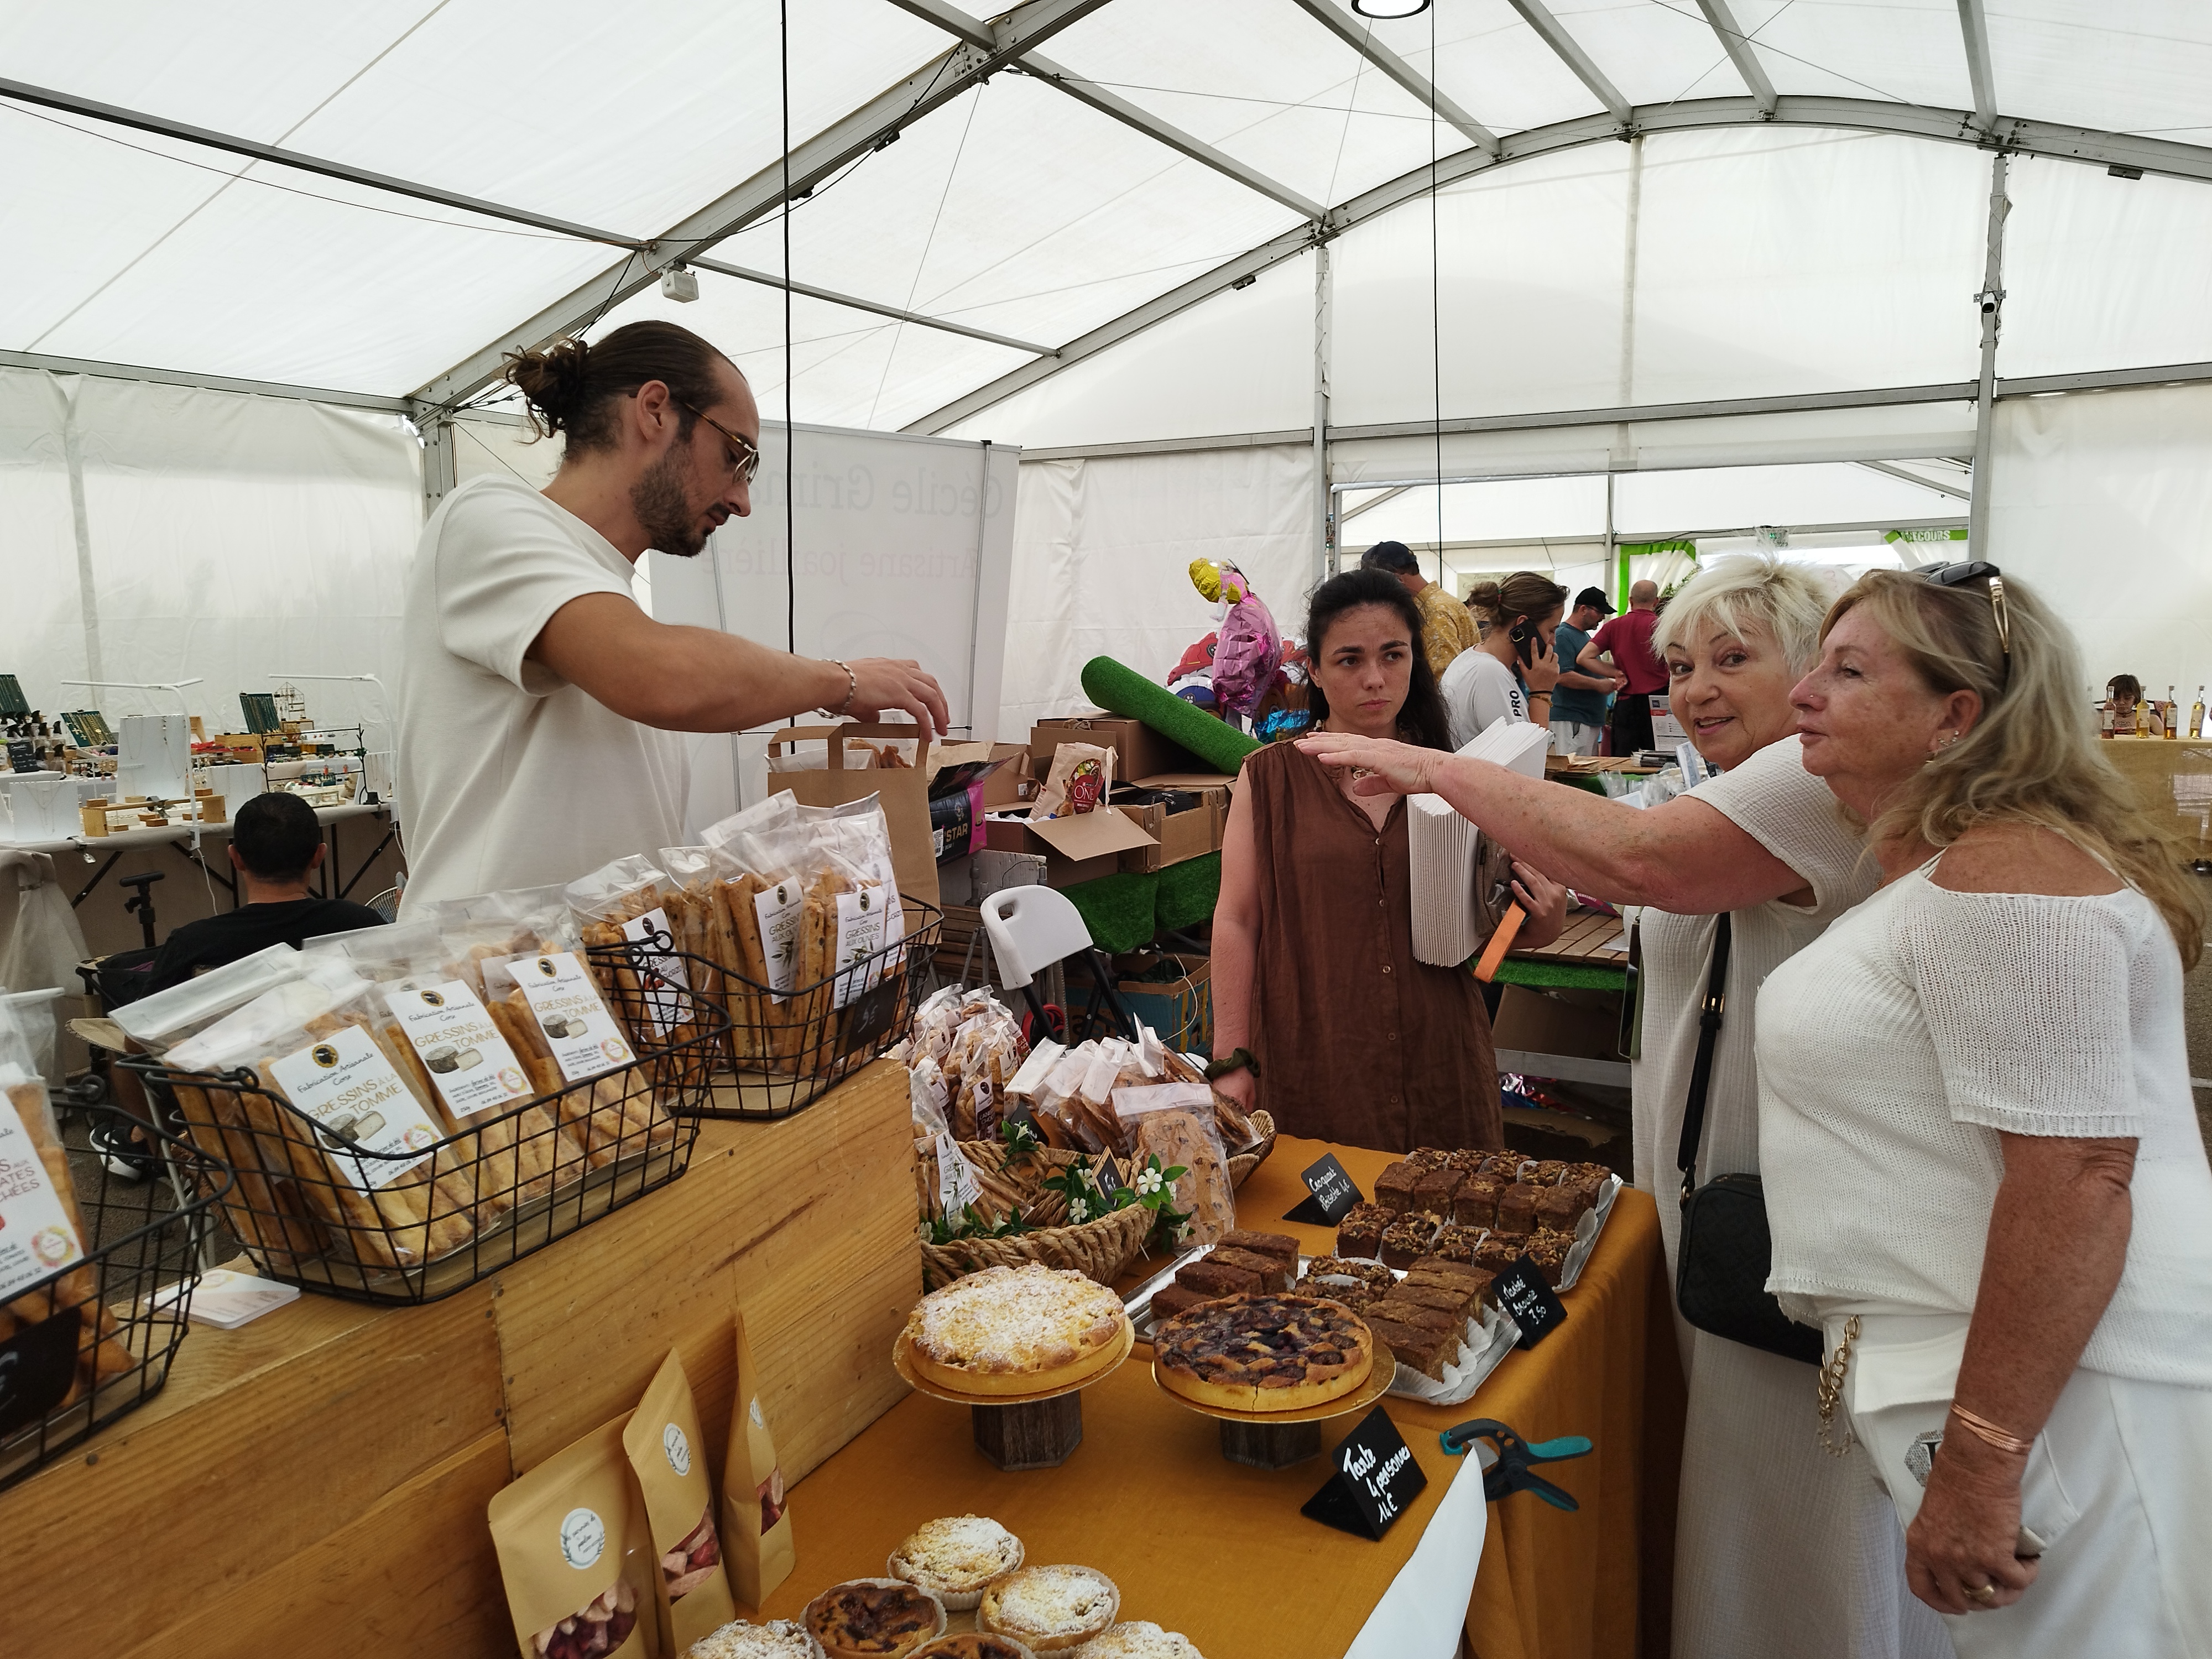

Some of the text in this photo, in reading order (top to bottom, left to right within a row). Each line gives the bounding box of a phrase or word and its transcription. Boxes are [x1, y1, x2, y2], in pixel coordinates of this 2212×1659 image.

[1509, 690, 1522, 717] PRO
[1074, 785, 1094, 800] ONE
[846, 922, 880, 939] GRESSINS
[858, 933, 879, 943] OLIVES
[534, 995, 583, 1012] GRESSINS
[562, 1002, 603, 1019] TOMME
[408, 1010, 445, 1022] Fabrication
[415, 1022, 478, 1047] GRESSINS
[452, 1029, 500, 1049] TOMME
[297, 1052, 374, 1093] Fabrication Artisanale
[333, 1074, 352, 1086] Corse
[306, 1079, 378, 1121] GRESSINS
[349, 1082, 403, 1115] TOMME
[1343, 1443, 1376, 1481] Tarte
[1366, 1477, 1381, 1498] 4
[1379, 1492, 1398, 1524] 14€
